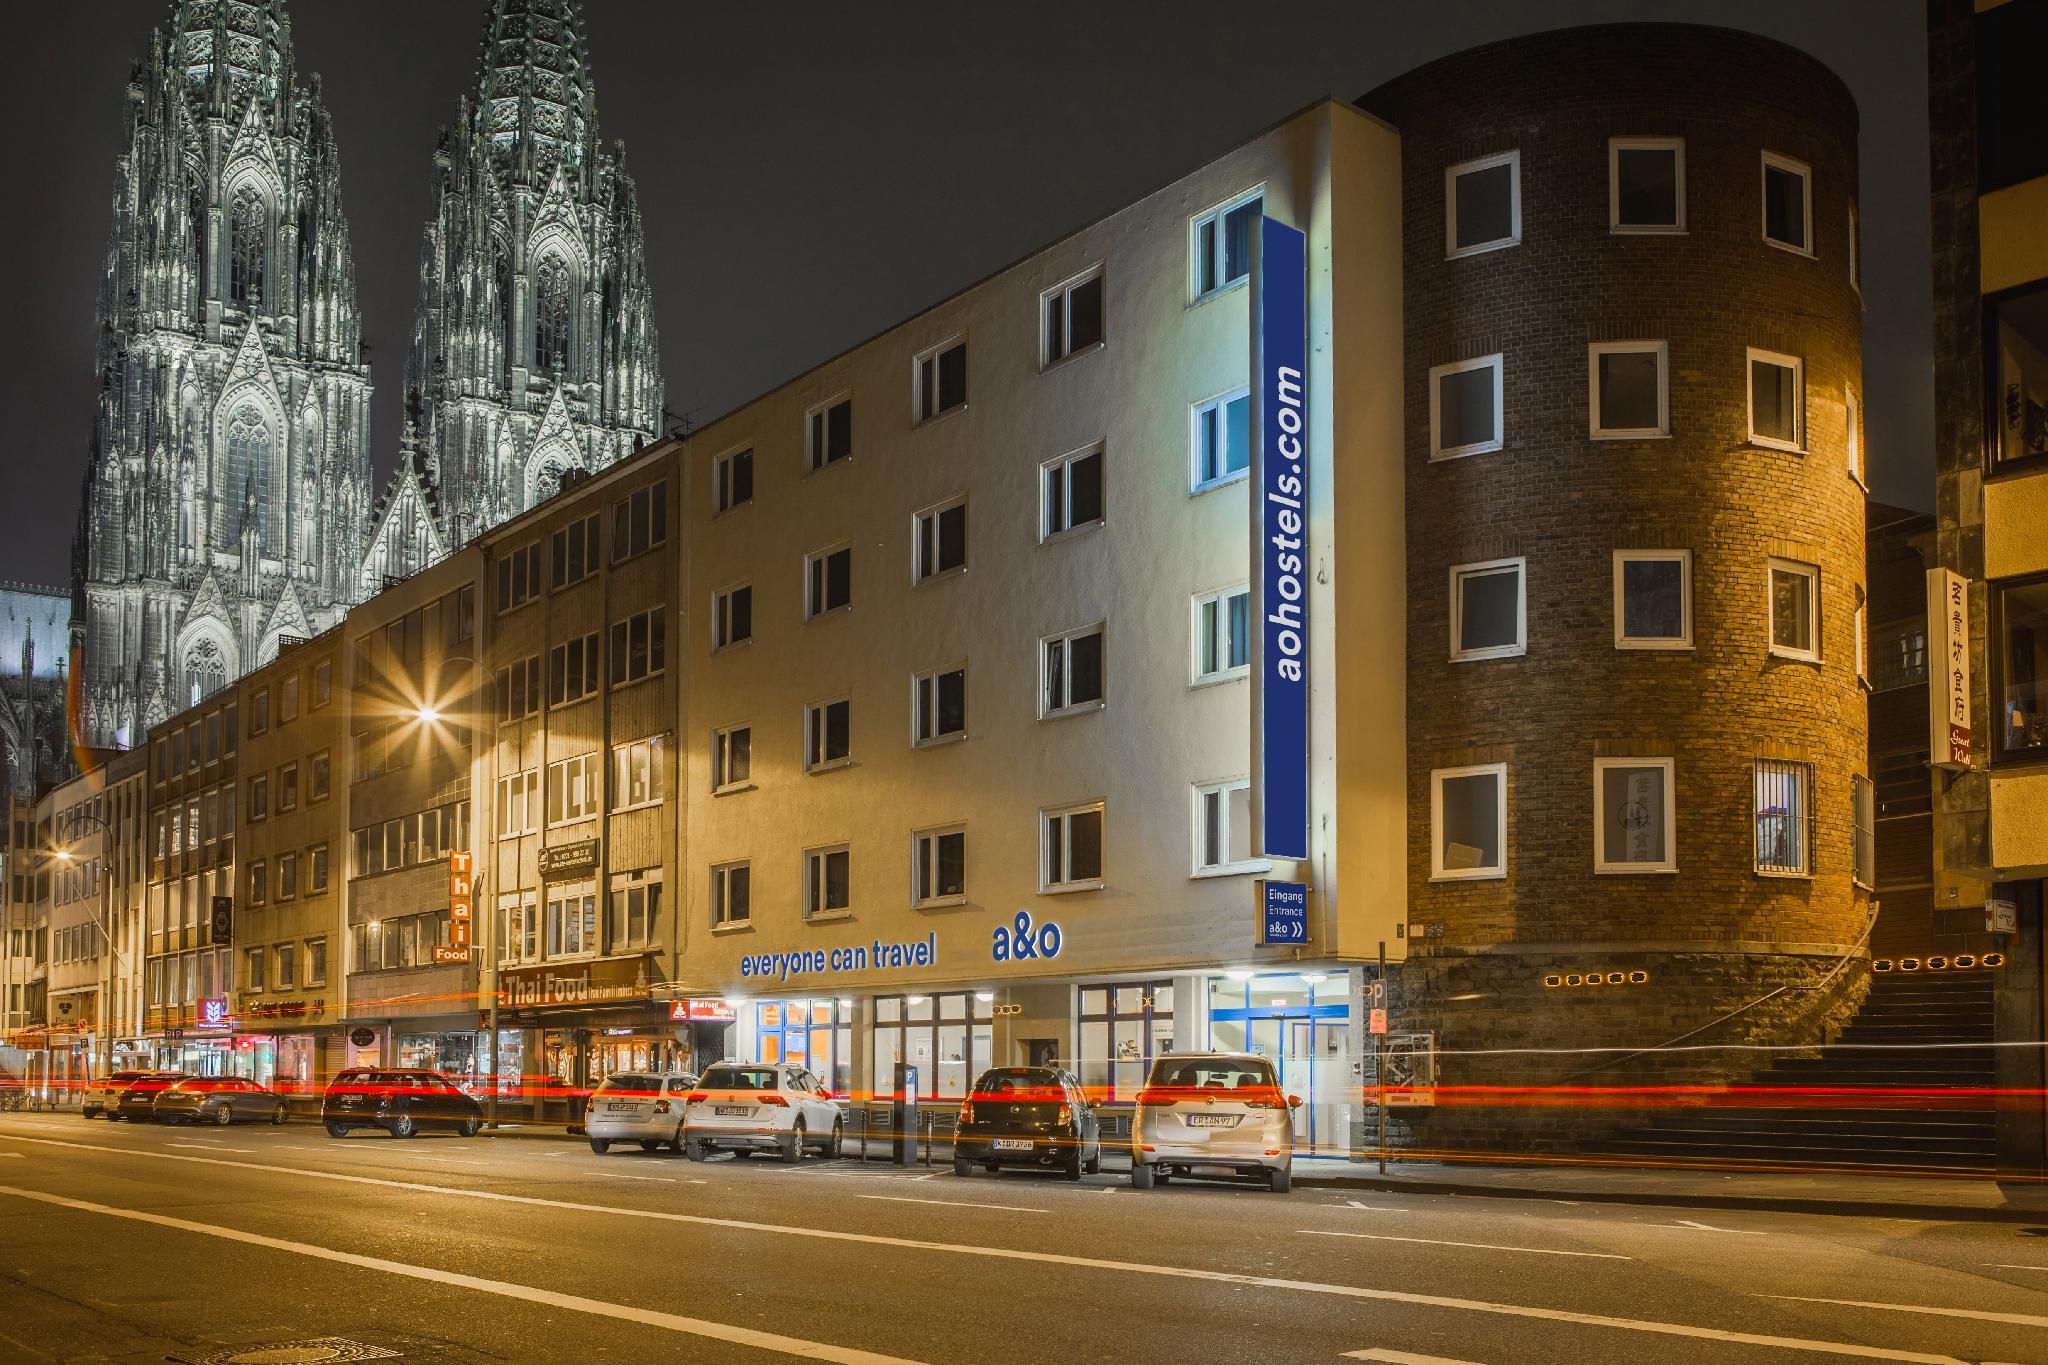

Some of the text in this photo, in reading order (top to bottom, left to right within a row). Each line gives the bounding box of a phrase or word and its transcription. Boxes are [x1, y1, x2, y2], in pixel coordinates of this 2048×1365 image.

[1268, 366, 1302, 682] ahostels.com
[1950, 729, 1970, 747] Great
[1953, 747, 1971, 765] Wall
[453, 853, 469, 943] Thai
[1269, 888, 1303, 904] Eingang
[1269, 904, 1303, 917] Entrance
[992, 911, 1062, 962] a&o
[1269, 921, 1288, 934] a&o
[436, 949, 468, 960] Food
[741, 932, 935, 981] everyone can travel
[506, 969, 588, 1004] Thai Food
[1374, 983, 1383, 1008] P
[907, 1071, 913, 1082] P
[1193, 1116, 1204, 1124] ER
[1220, 1117, 1231, 1125] 97
